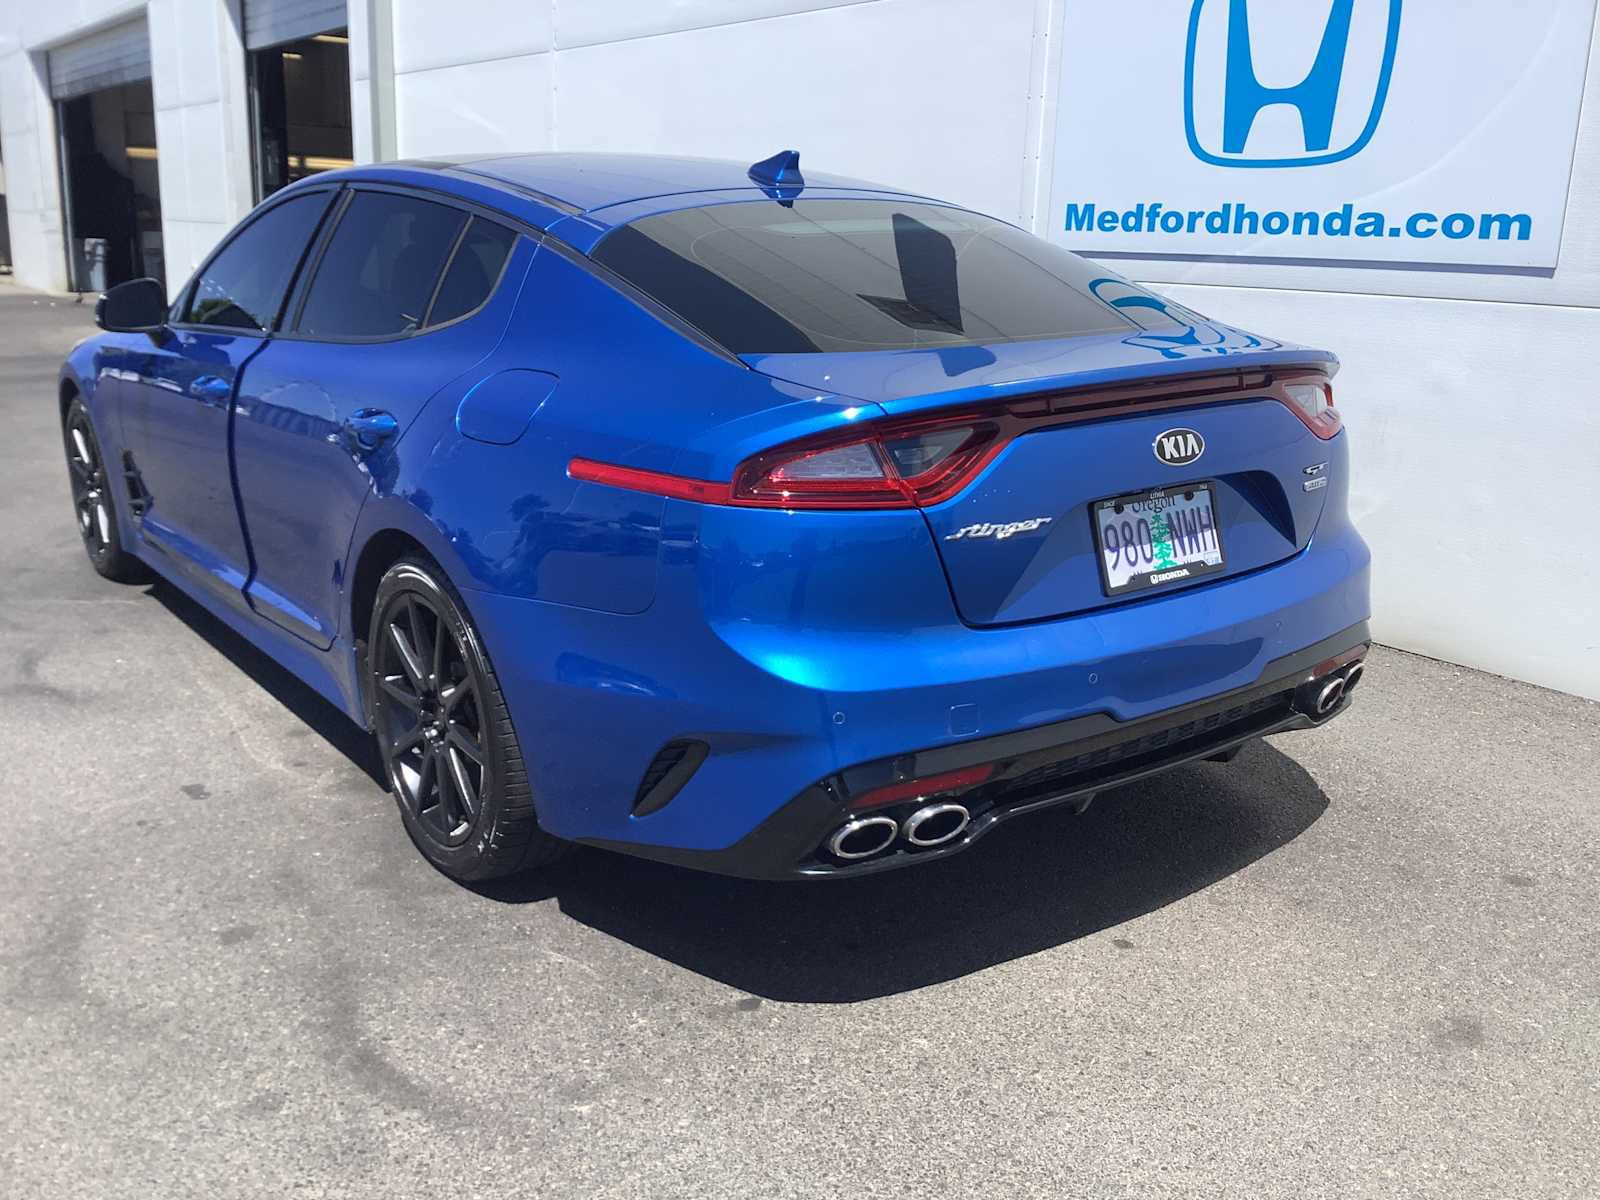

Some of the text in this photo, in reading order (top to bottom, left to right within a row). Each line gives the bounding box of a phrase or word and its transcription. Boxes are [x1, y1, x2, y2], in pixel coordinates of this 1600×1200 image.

[1064, 202, 1533, 241] Medfordhonda.com
[1161, 433, 1200, 460] KIA
[1104, 505, 1217, 571] 980 NWH
[1158, 569, 1190, 582] HONDA
